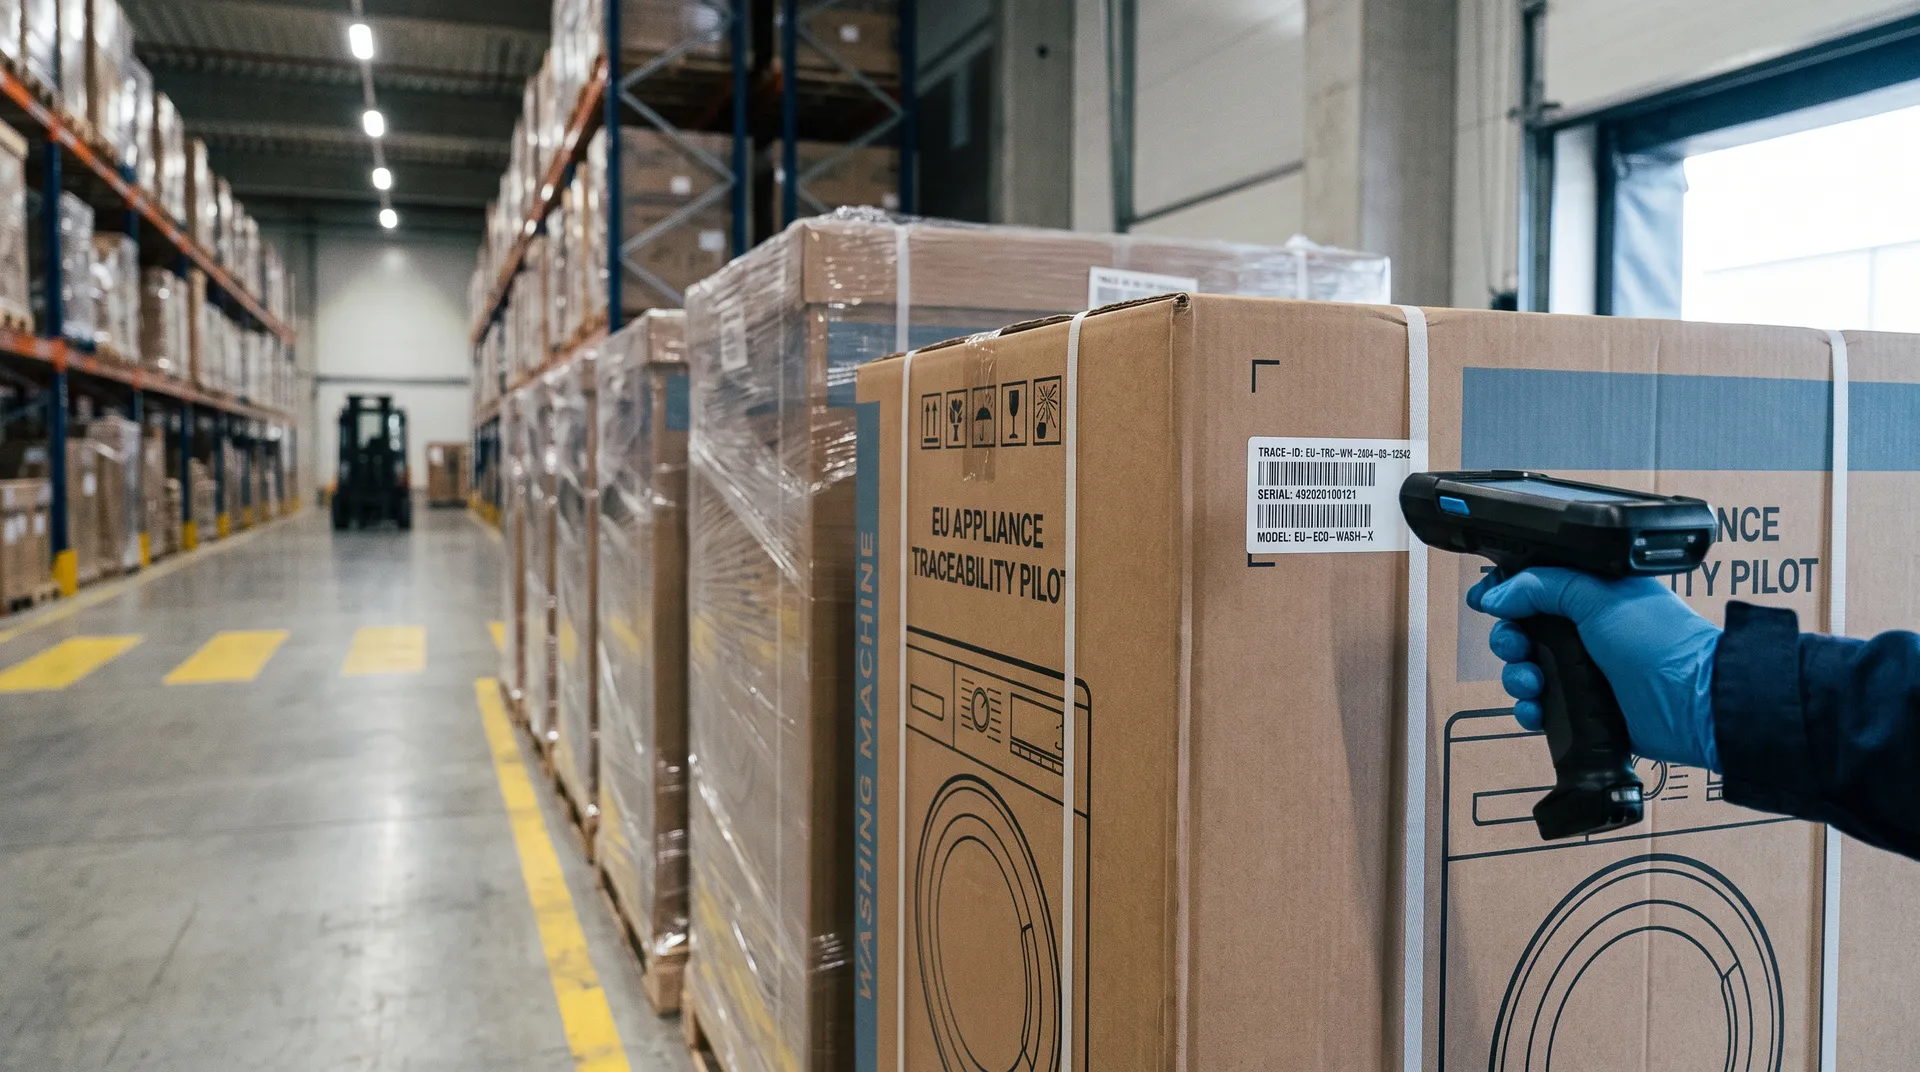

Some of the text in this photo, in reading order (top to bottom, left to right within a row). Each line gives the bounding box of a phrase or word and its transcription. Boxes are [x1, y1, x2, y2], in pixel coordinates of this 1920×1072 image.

[1258, 447, 1304, 458] TRACE-ID:
[1257, 489, 1357, 500] SERIAL: 492020100121
[931, 506, 1044, 549] EU APPLIANCE
[1257, 531, 1374, 543] MODEL: EU-ECO-WASH-X
[911, 546, 1016, 595] TRACEABILITY
[1730, 557, 1819, 596] PILOT
[859, 531, 873, 1000] WASHING MACHINE
